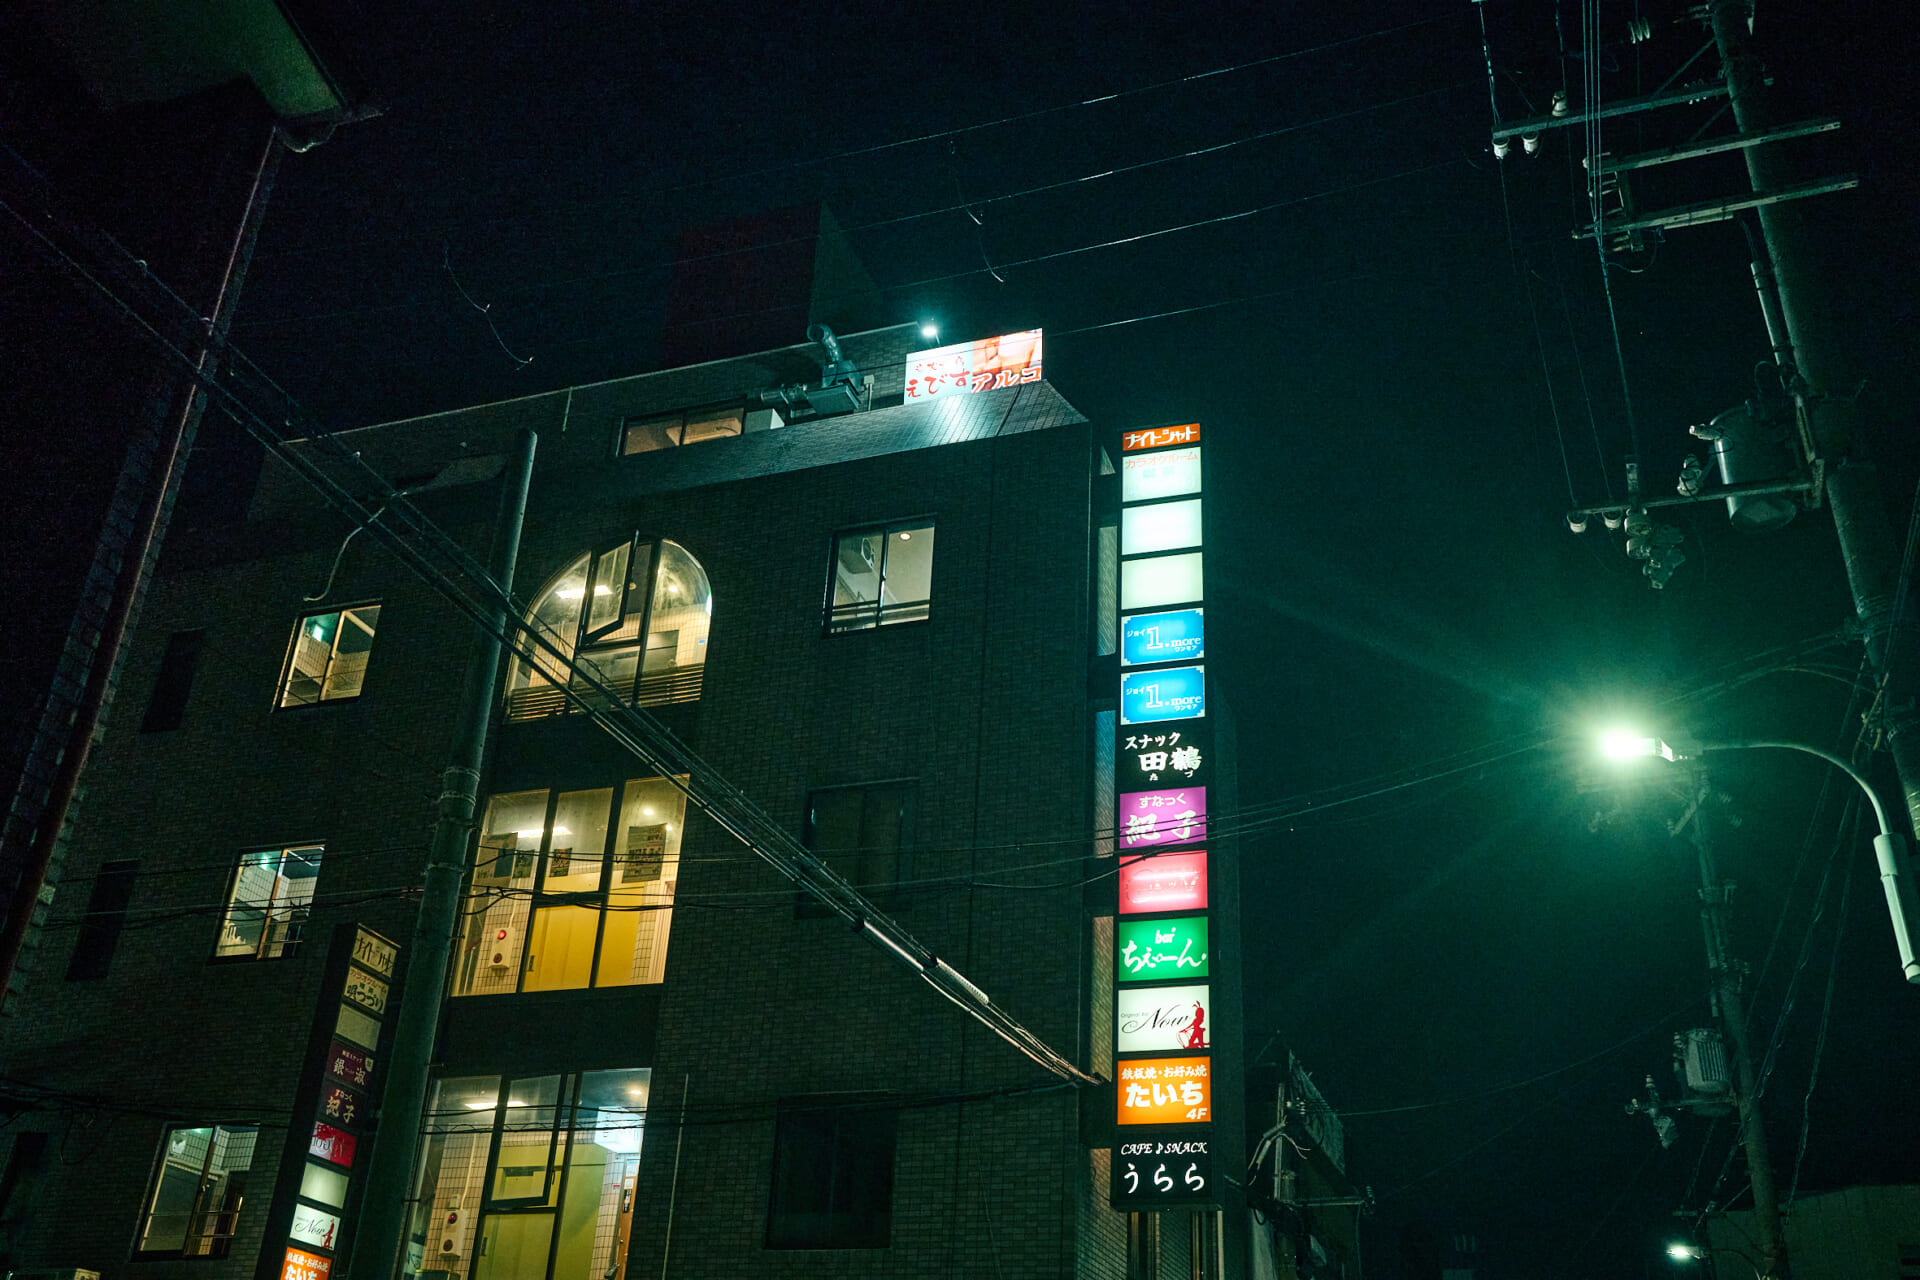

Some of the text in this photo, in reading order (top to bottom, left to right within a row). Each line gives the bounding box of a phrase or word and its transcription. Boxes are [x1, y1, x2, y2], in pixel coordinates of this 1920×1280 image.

[1125, 451, 1199, 470] カラオケルーム
[1124, 731, 1181, 750] スナック
[1125, 1080, 1204, 1108] たいち
[1186, 1107, 1208, 1120] 4F
[1121, 1141, 1208, 1155] CAFE SNACK
[1124, 1162, 1205, 1194] うらら
